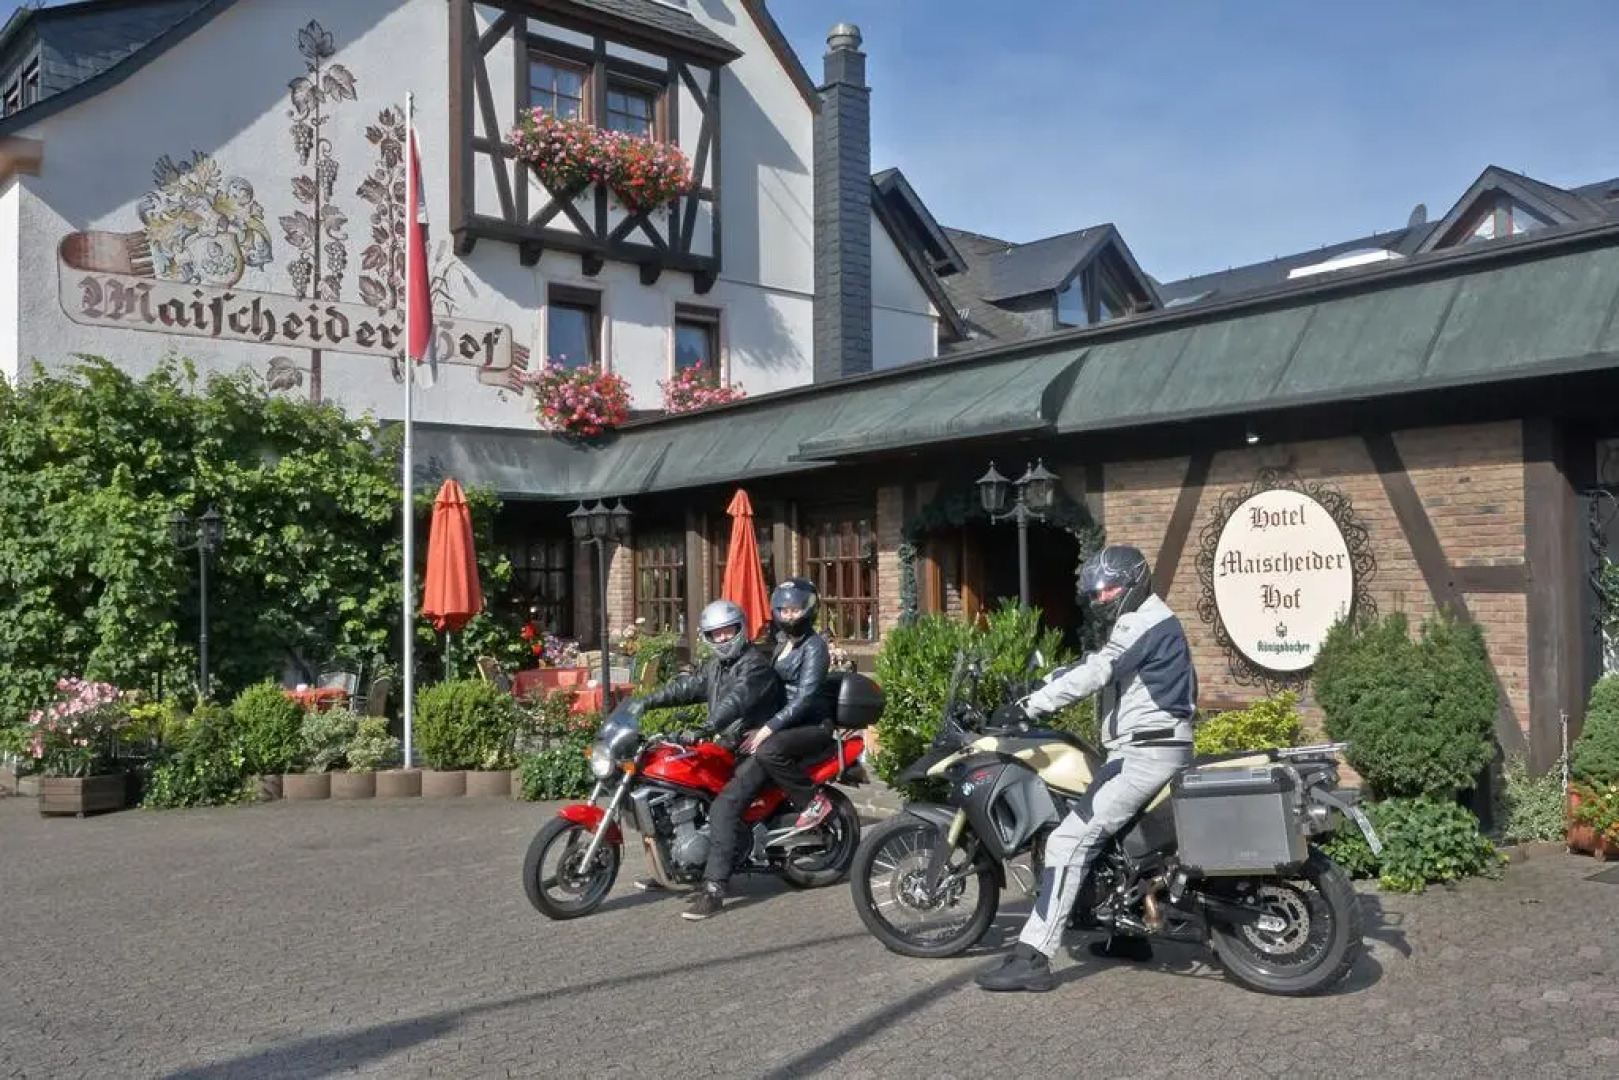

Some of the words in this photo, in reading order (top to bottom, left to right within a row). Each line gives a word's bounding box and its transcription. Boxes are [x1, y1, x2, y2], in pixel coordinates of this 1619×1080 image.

[1249, 504, 1306, 531] Hotel
[1219, 550, 1346, 576] Maischeider
[1260, 584, 1302, 613] Hof
